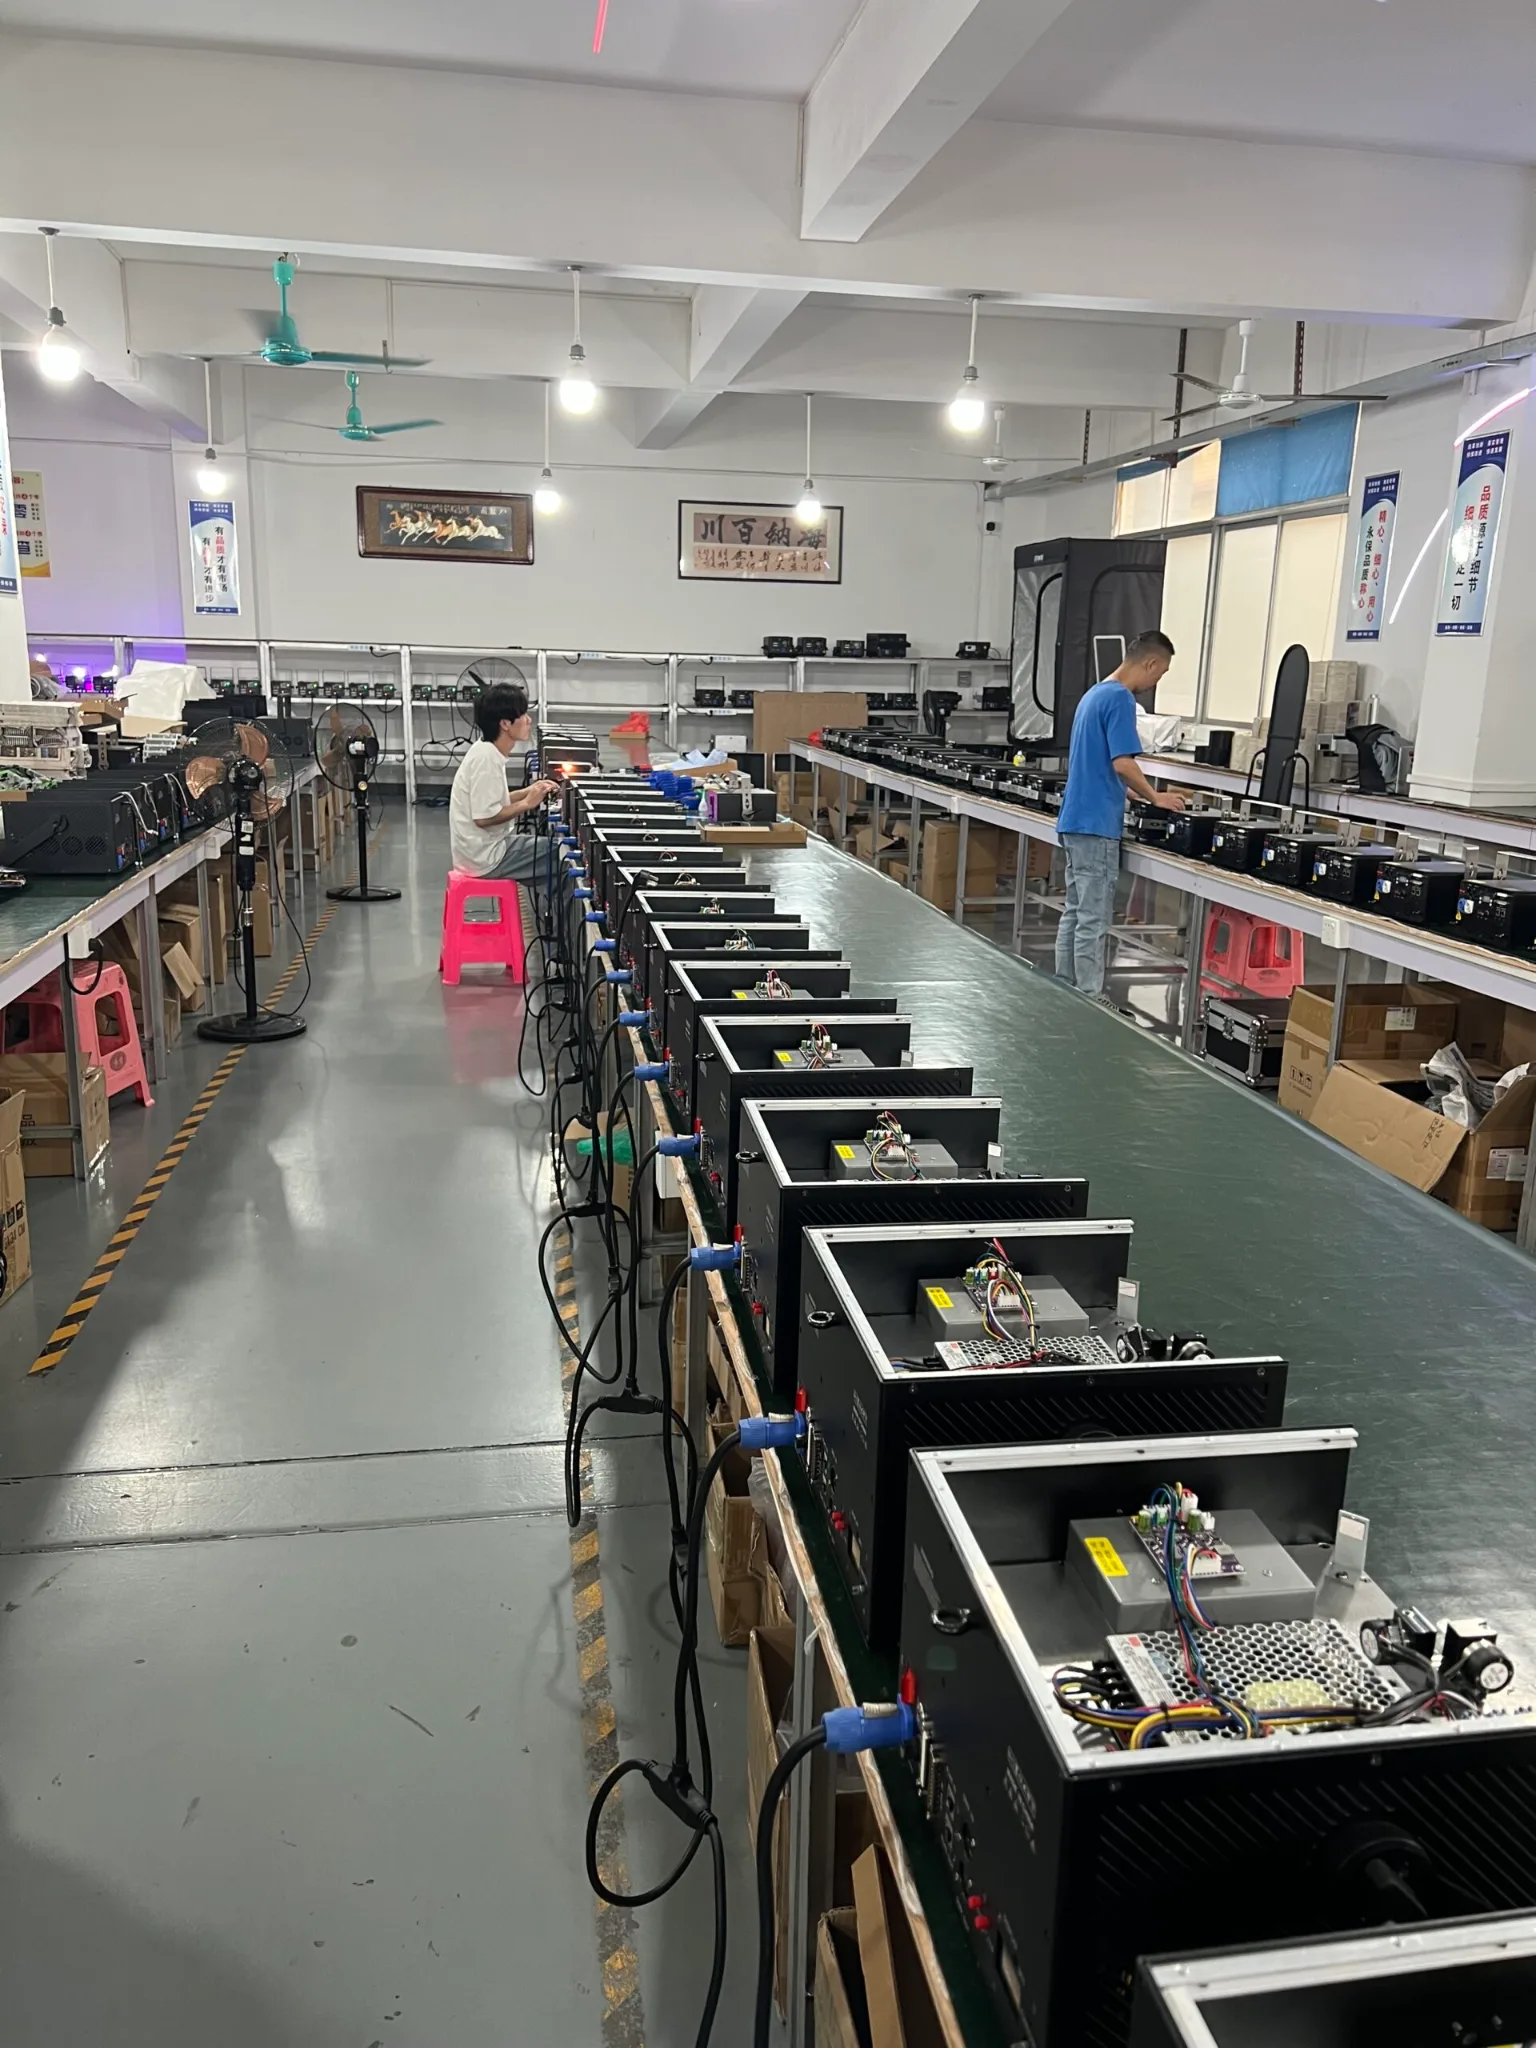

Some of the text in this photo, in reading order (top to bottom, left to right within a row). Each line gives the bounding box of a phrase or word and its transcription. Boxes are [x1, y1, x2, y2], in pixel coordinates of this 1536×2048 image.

[202, 537, 214, 602] 有才有进步
[1359, 526, 1374, 608] 永保品质称心
